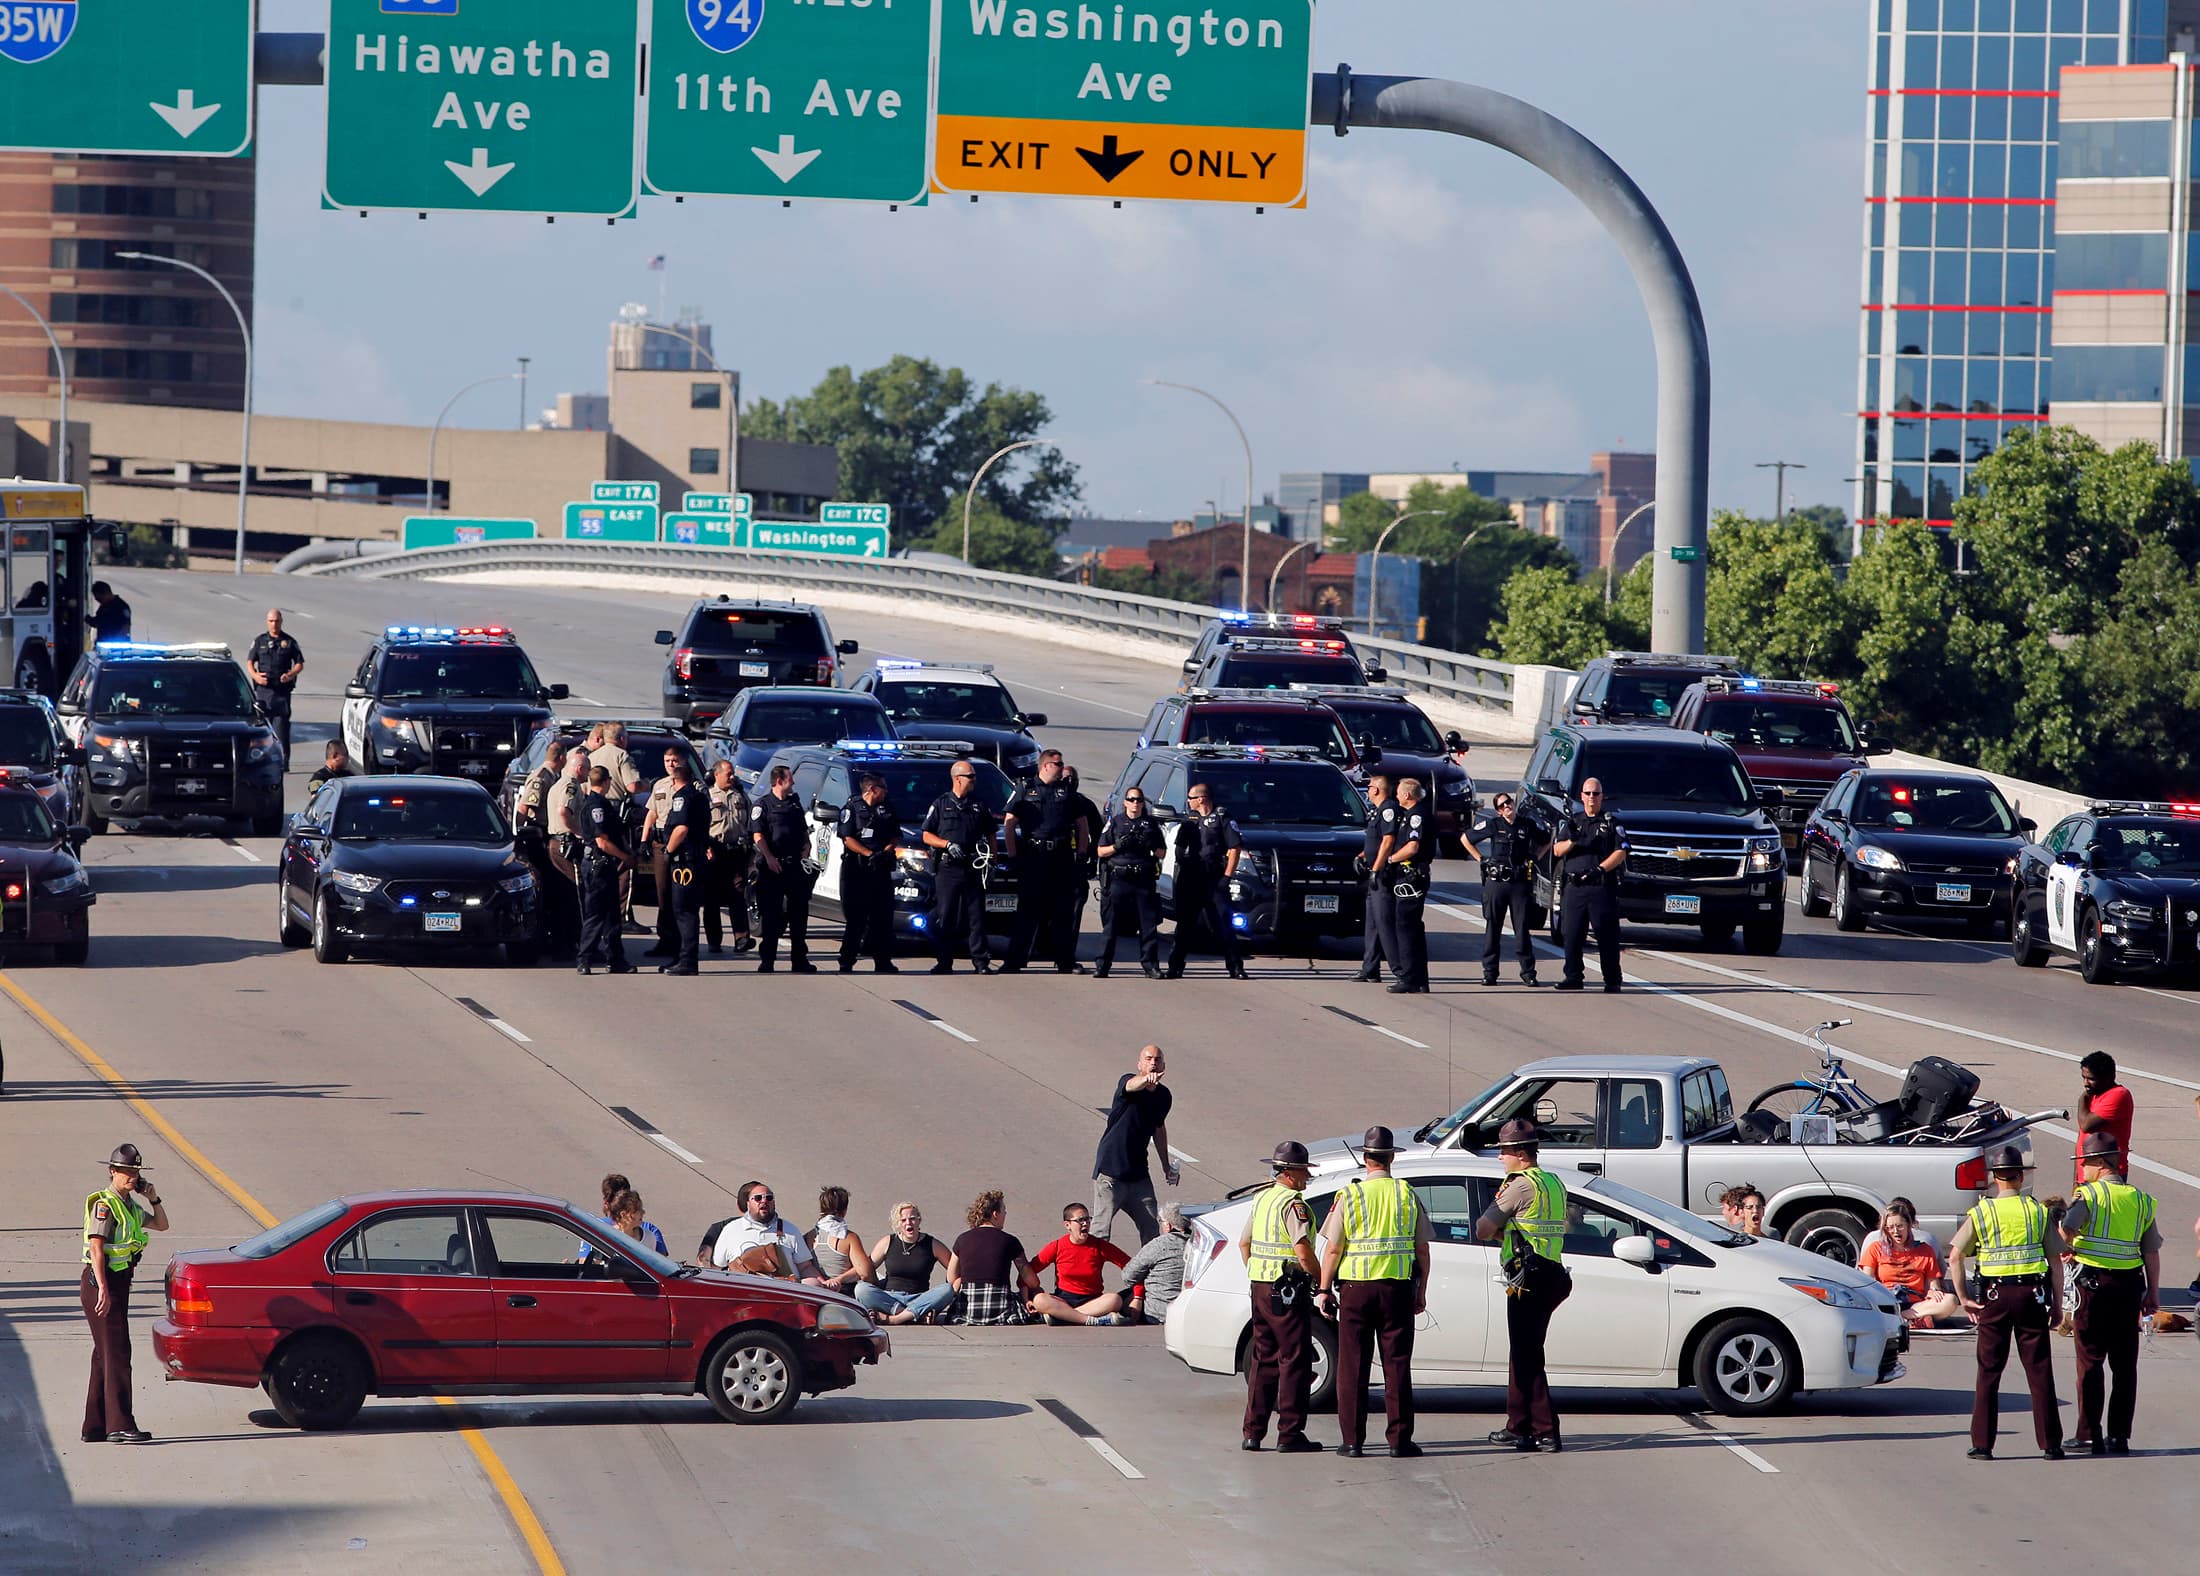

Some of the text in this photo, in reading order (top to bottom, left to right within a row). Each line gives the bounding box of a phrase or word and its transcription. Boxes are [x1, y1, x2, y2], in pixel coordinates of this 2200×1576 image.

[698, 0, 751, 32] 94
[969, 0, 1283, 57] Washington
[355, 33, 610, 78] Hiawatha
[1076, 62, 1172, 102] Ave
[675, 73, 901, 119] 11th Ave
[432, 91, 531, 131] Ave
[961, 139, 1049, 170] EXIT
[1169, 148, 1277, 179] ONLY
[626, 486, 654, 499] 17A
[609, 509, 643, 522] EAST
[856, 508, 883, 521] 17C
[582, 519, 600, 534] 55
[677, 527, 695, 540] 94
[759, 529, 857, 549] Washington
[894, 886, 919, 898] 1409
[1314, 898, 1336, 909] POLICE
[1357, 1241, 1408, 1251] STATE PATROL
